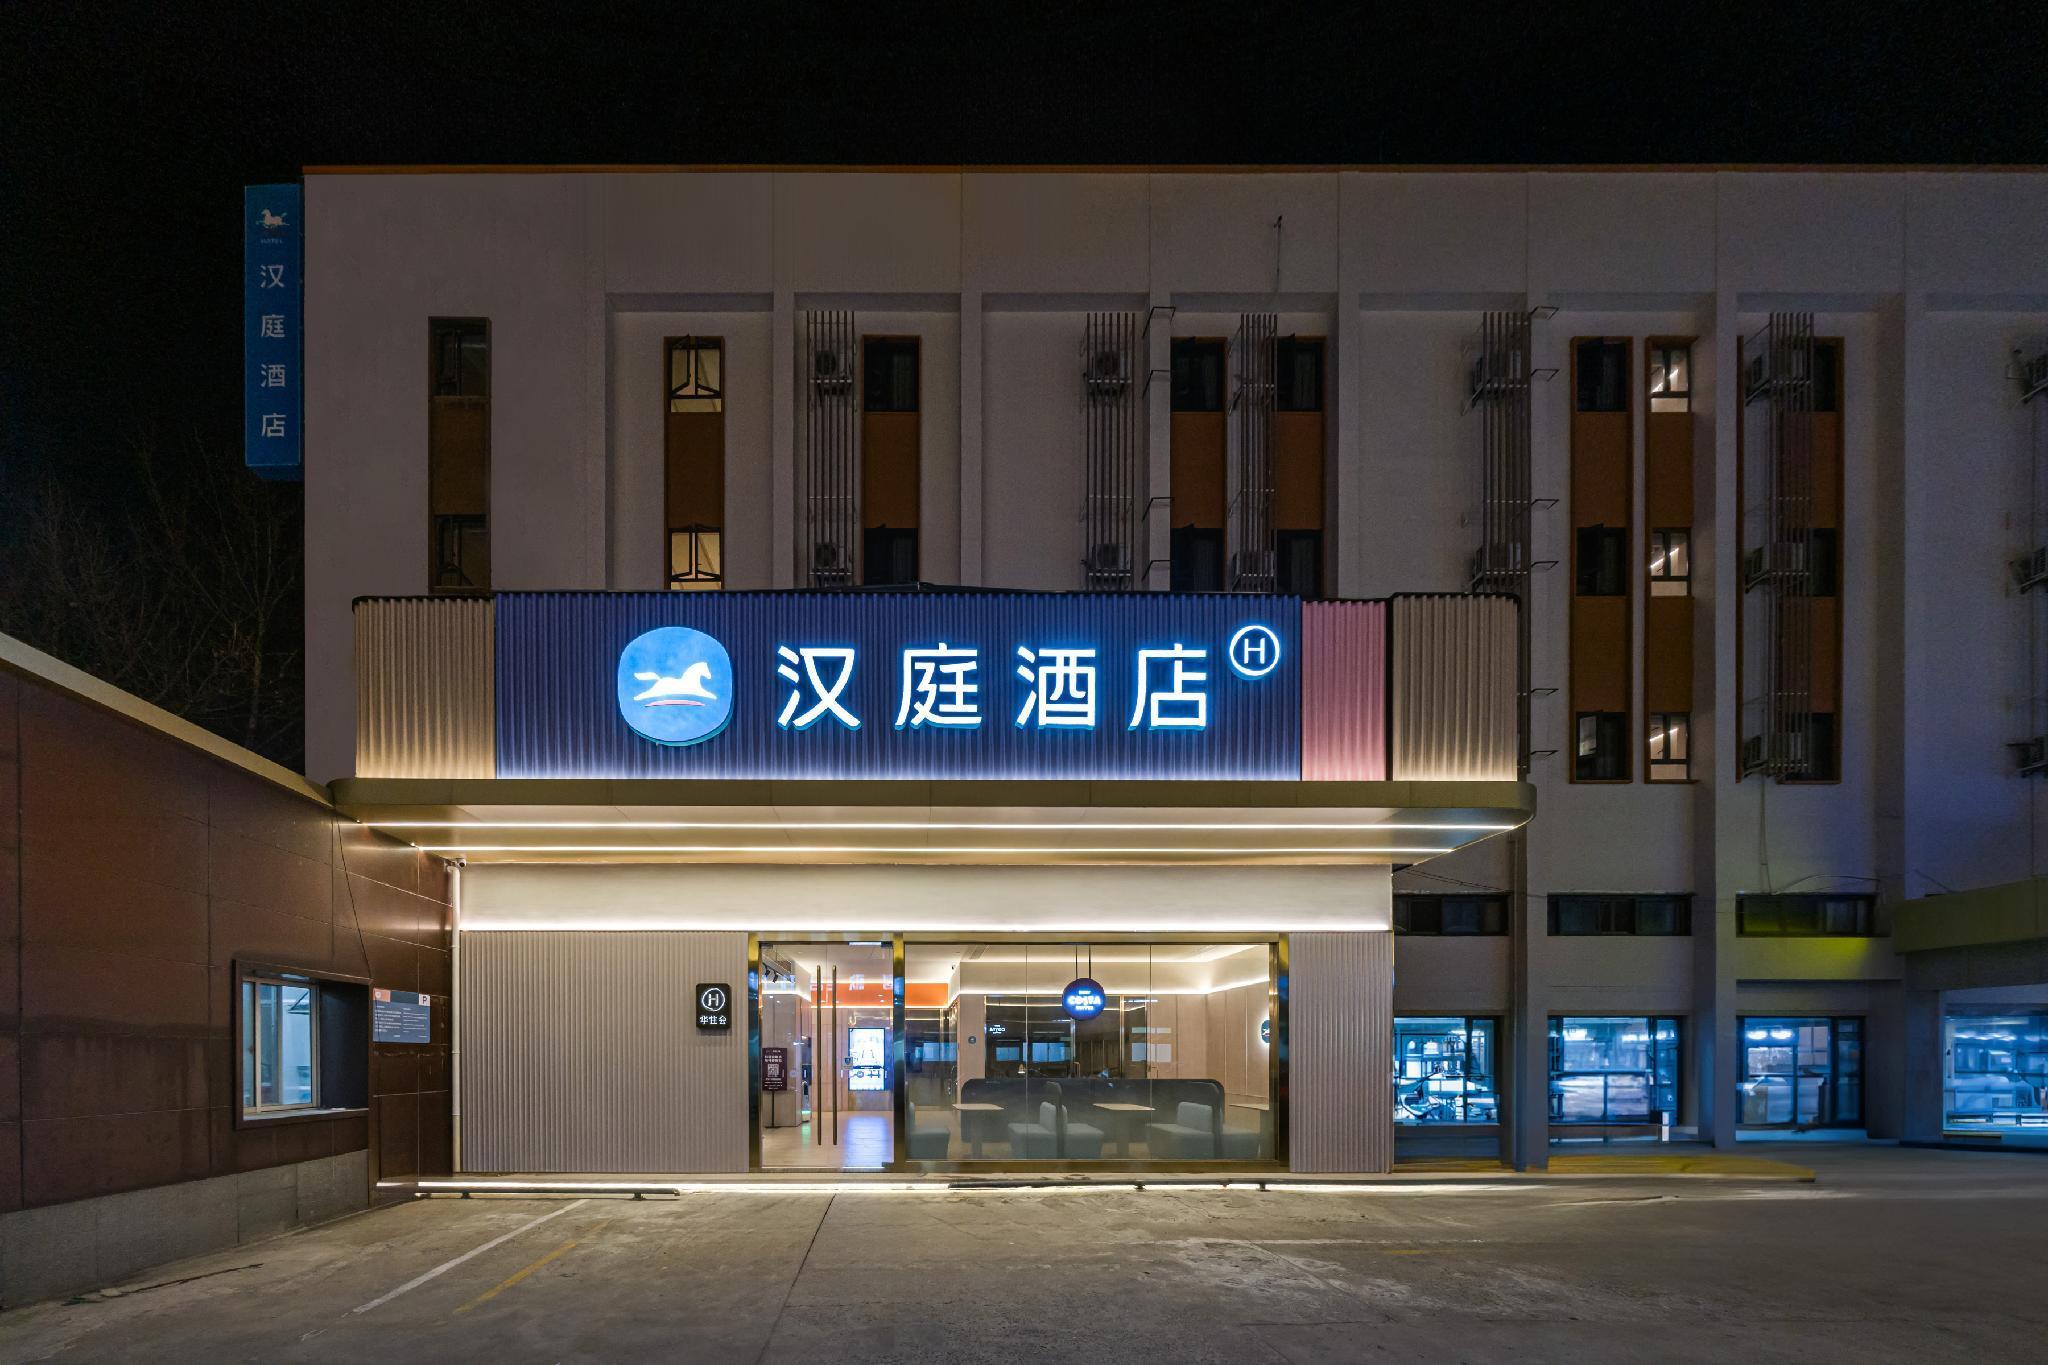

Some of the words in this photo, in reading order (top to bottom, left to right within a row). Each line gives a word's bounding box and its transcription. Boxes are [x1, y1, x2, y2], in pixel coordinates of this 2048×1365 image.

[260, 264, 286, 438] 汉庭酒店
[776, 642, 1209, 731] 汉庭酒店
[422, 996, 428, 1005] P
[1068, 995, 1101, 1005] COSTA
